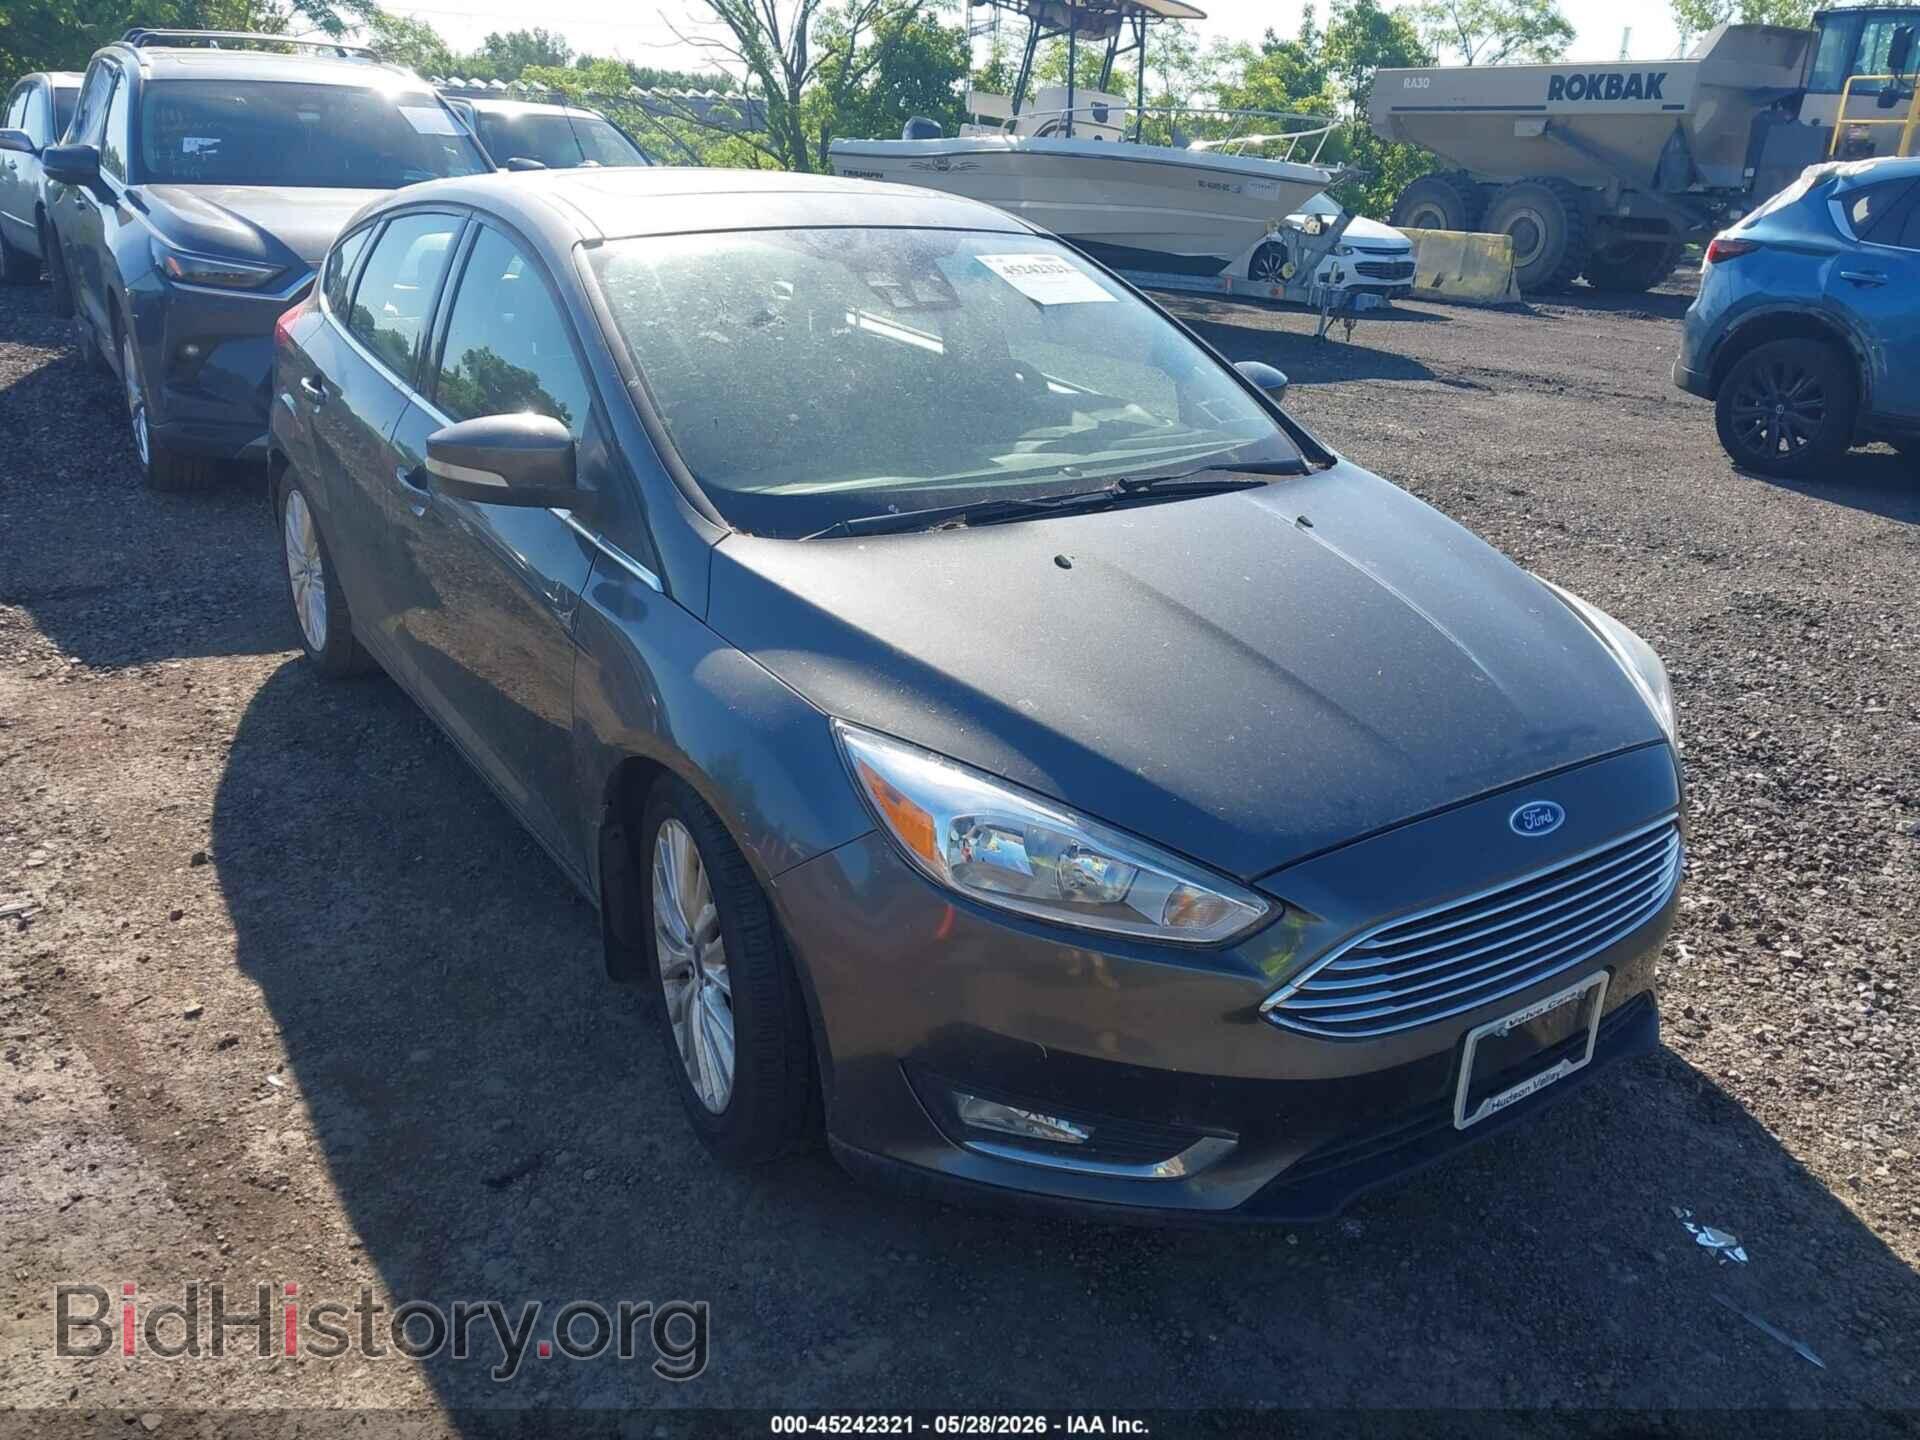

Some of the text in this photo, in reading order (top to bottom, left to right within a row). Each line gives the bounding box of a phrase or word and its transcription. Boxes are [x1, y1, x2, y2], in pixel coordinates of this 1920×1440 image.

[1403, 77, 1431, 89] RA30
[1547, 72, 1668, 100] ROKBAK
[1522, 807, 1554, 830] Ford
[1491, 1069, 1561, 1111] Hudson Valley
